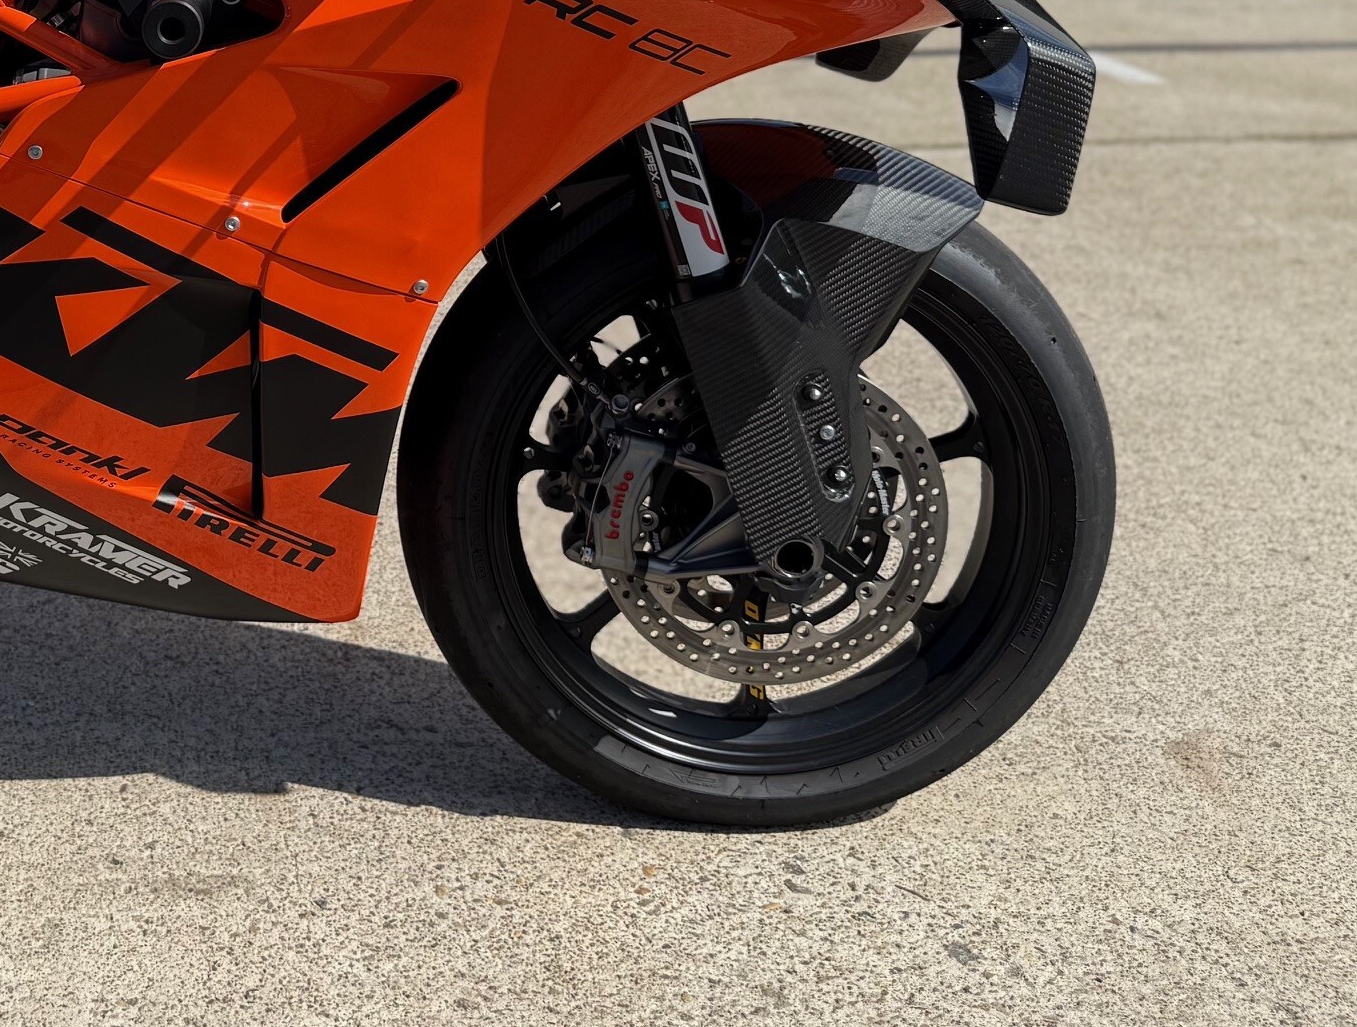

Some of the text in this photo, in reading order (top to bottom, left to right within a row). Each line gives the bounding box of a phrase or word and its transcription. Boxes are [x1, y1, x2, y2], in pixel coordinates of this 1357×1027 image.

[628, 28, 733, 76] 8C
[642, 145, 661, 182] APEX
[0, 433, 118, 489] RACING SYSTEMS
[151, 473, 337, 573] PIRELLI
[604, 470, 635, 540] brembo
